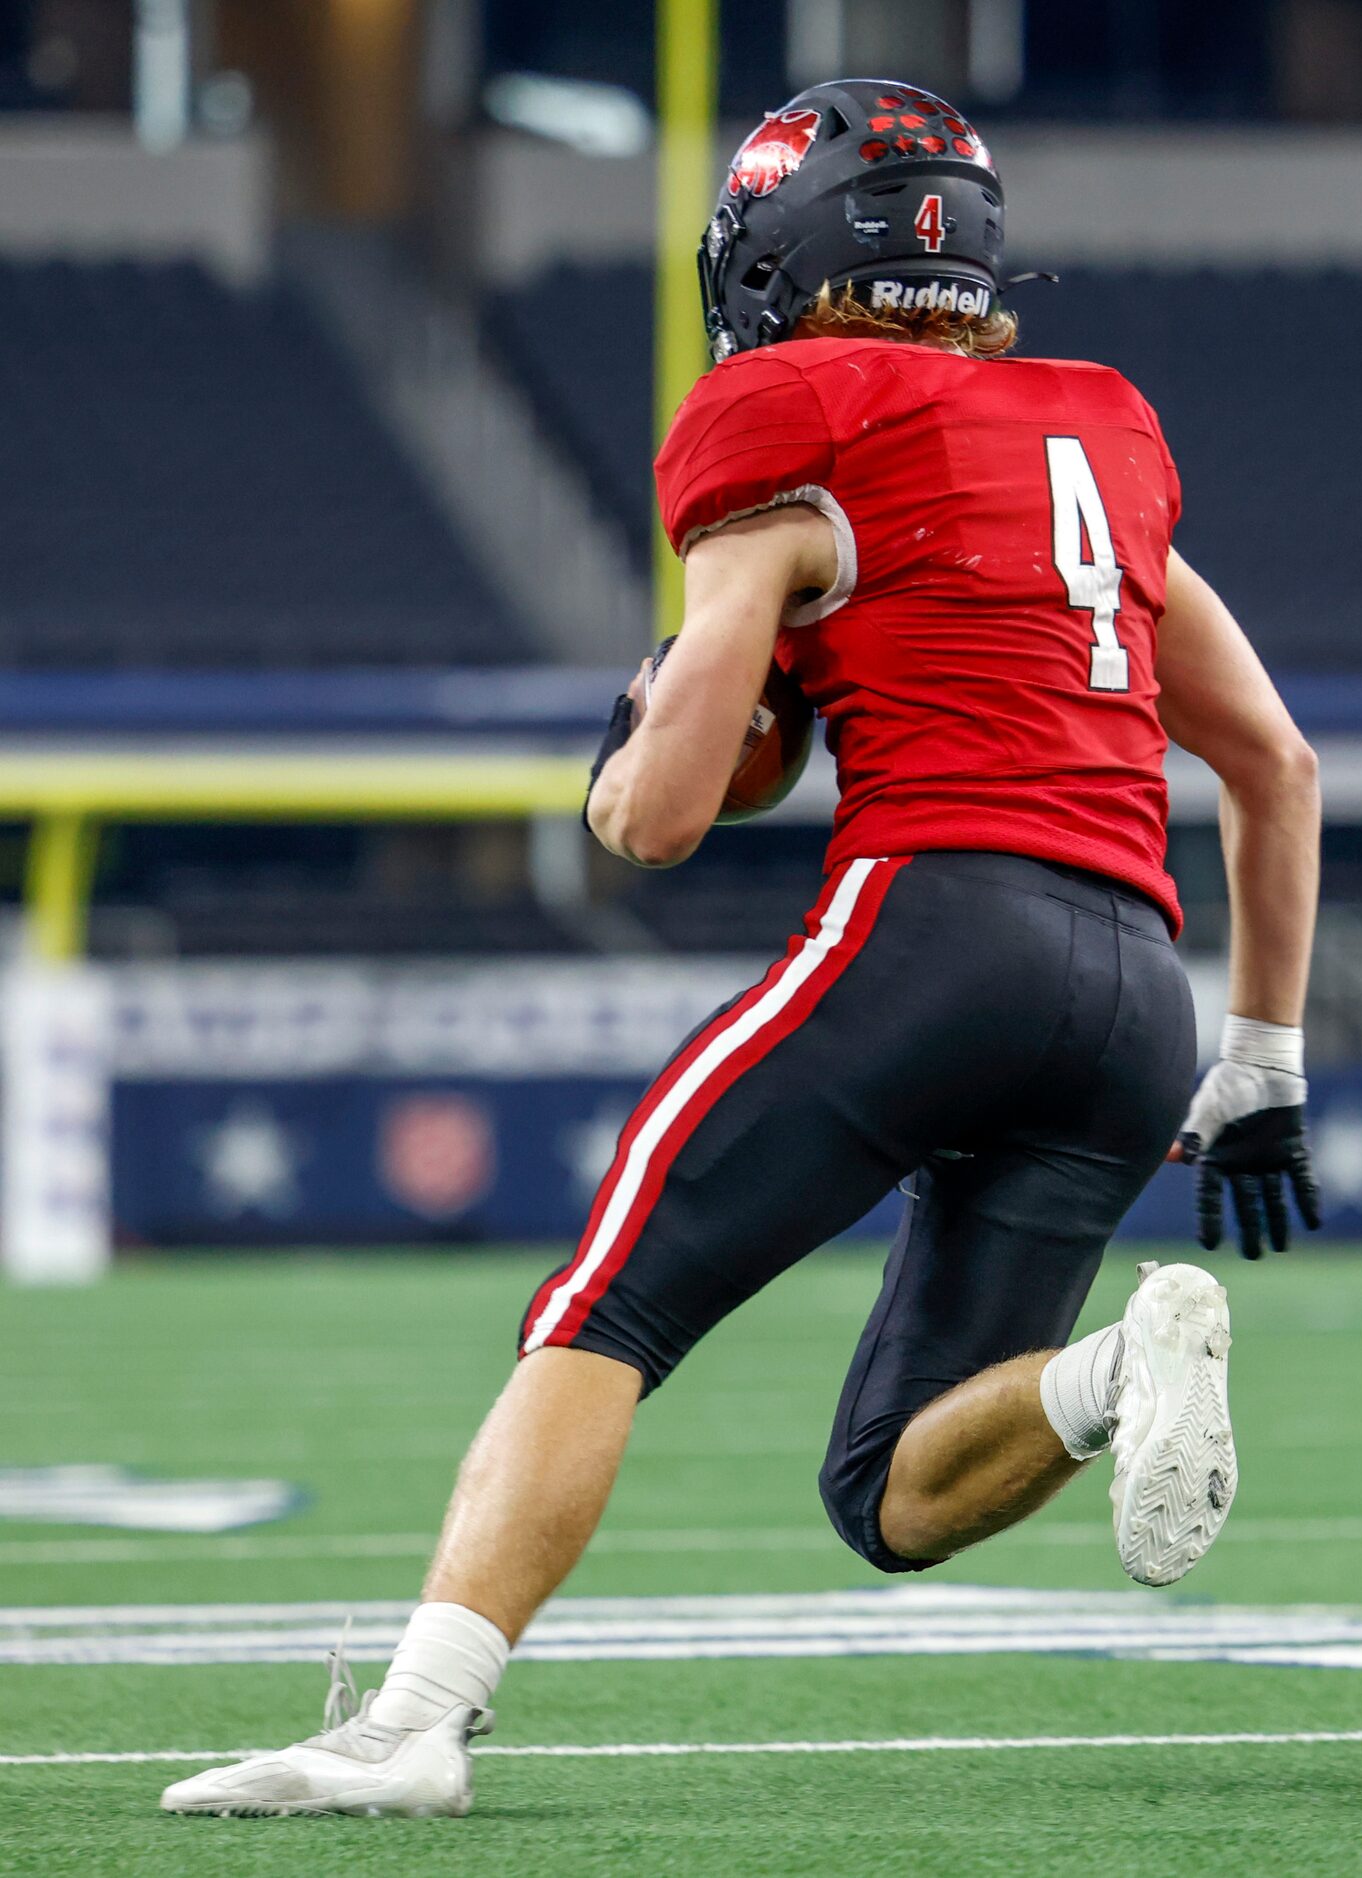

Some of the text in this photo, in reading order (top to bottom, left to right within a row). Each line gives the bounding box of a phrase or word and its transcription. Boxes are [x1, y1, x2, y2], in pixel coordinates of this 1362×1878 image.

[914, 194, 945, 252] 4
[871, 281, 990, 318] Riddell
[1043, 434, 1130, 693] 4
